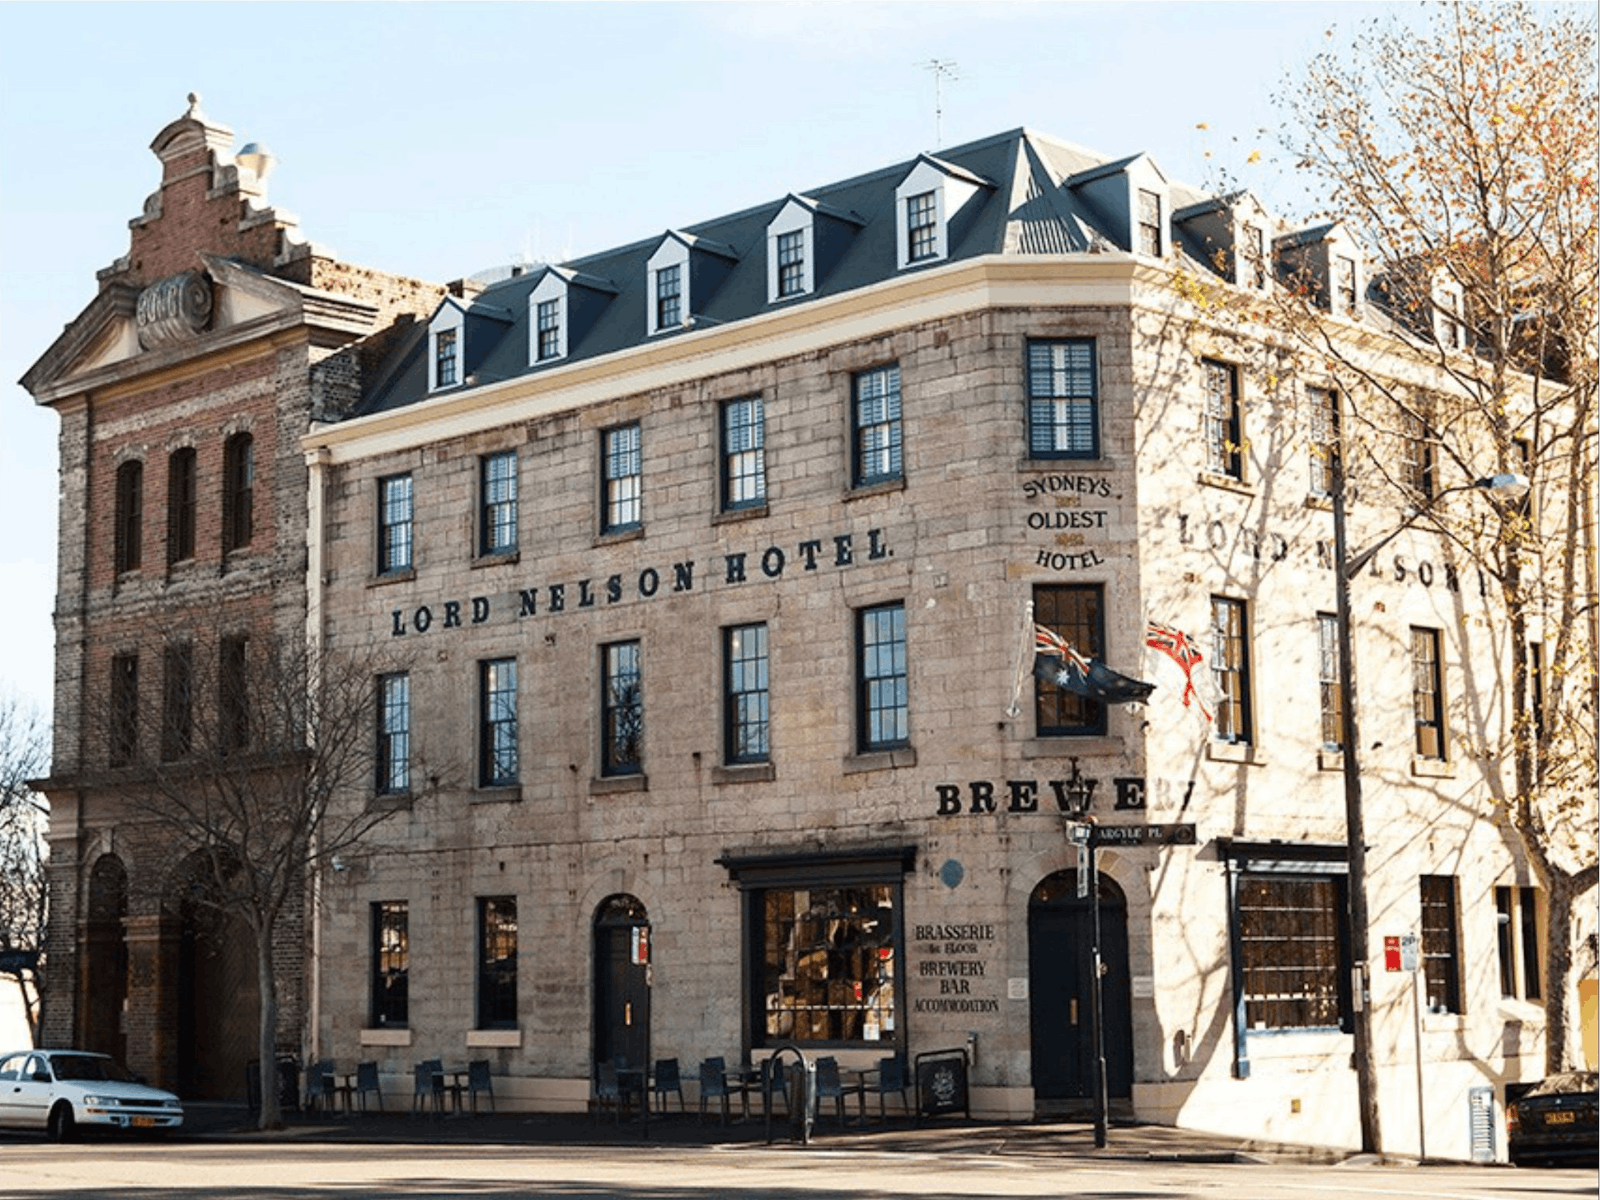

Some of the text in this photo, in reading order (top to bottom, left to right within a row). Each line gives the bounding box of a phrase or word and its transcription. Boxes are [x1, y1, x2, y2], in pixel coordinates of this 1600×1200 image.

[1022, 474, 1112, 499] SYDNEY'S
[1027, 510, 1108, 530] OLDEST
[1035, 549, 1105, 571] HOTEL
[1315, 539, 1459, 593] NLSON
[391, 528, 894, 637] LORD NELSON HOTEL.
[1100, 827, 1162, 839] ARGYLE PL
[915, 924, 995, 941] BRASSERIE
[944, 943, 978, 954] FLOOR
[919, 961, 987, 977] BREWERY
[940, 978, 970, 995] BAR
[913, 998, 1000, 1014] ACCOMMODATION
